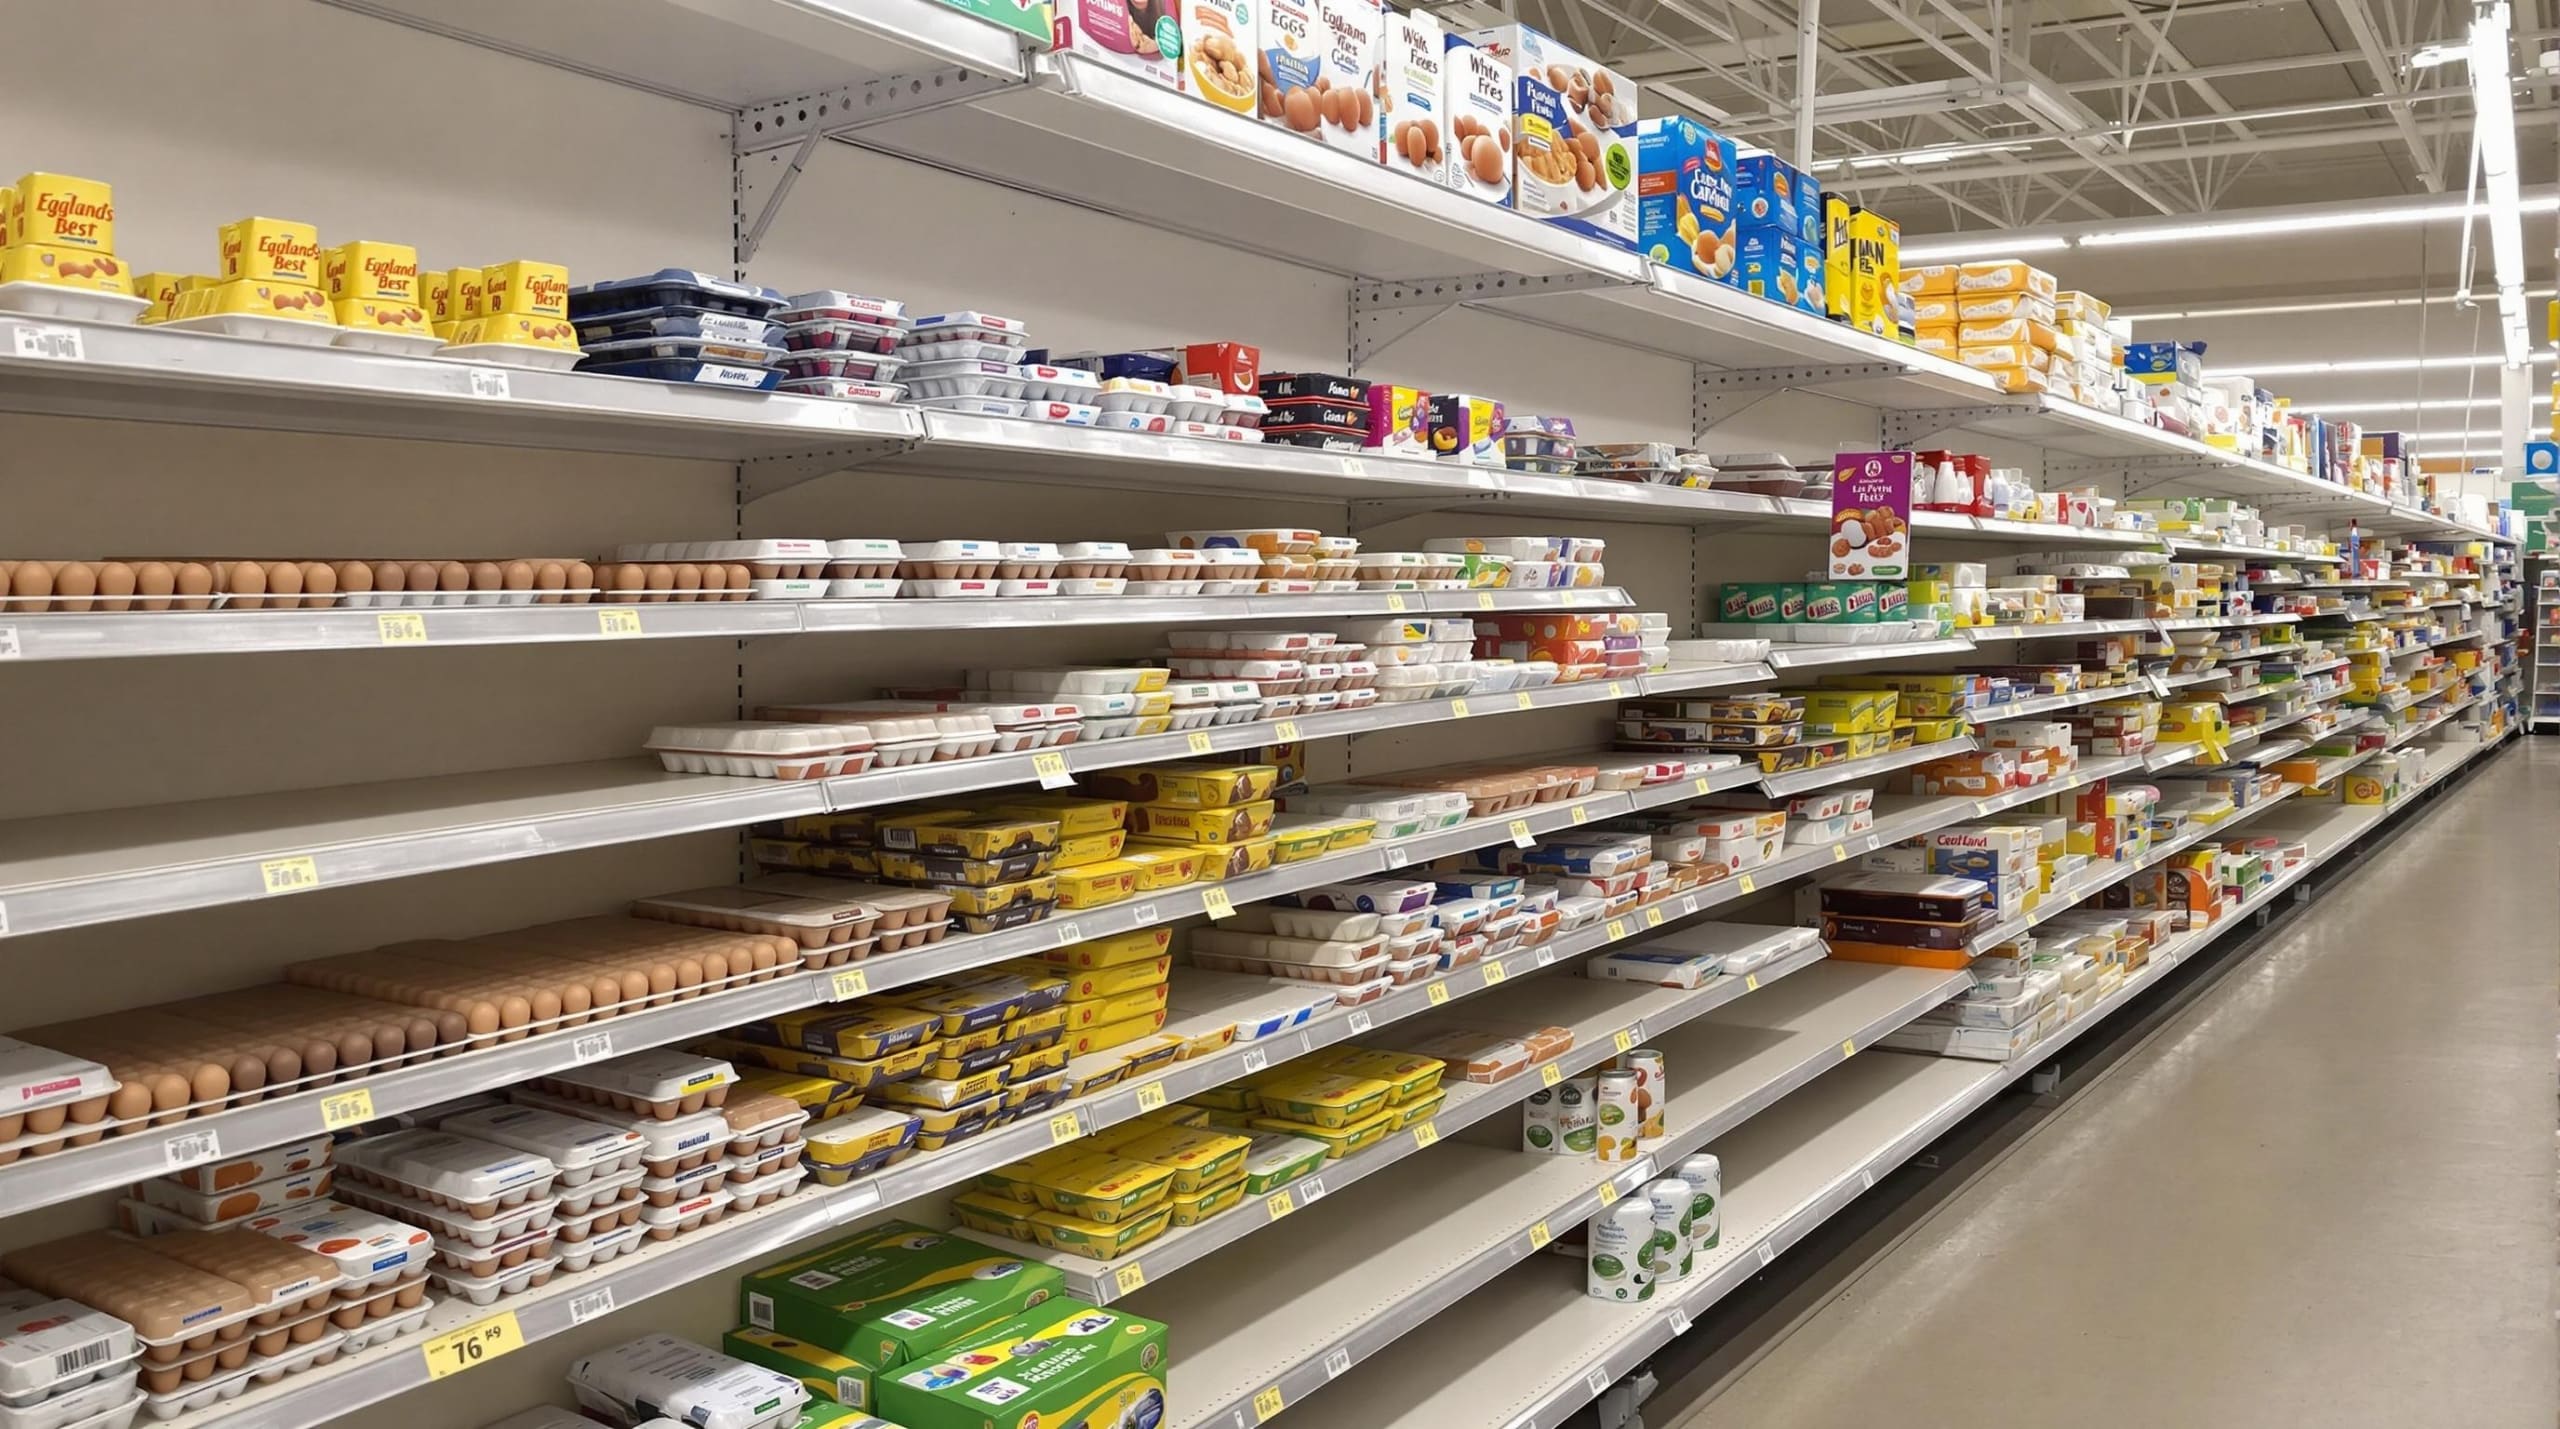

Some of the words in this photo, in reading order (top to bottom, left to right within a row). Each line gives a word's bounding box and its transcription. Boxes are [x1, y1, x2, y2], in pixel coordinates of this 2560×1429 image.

[1271, 9, 1306, 39] EGGS
[1469, 53, 1500, 83] White
[53, 218, 98, 237] Best
[272, 256, 307, 273] Best
[377, 275, 411, 291] Best
[451, 1336, 483, 1364] 76
